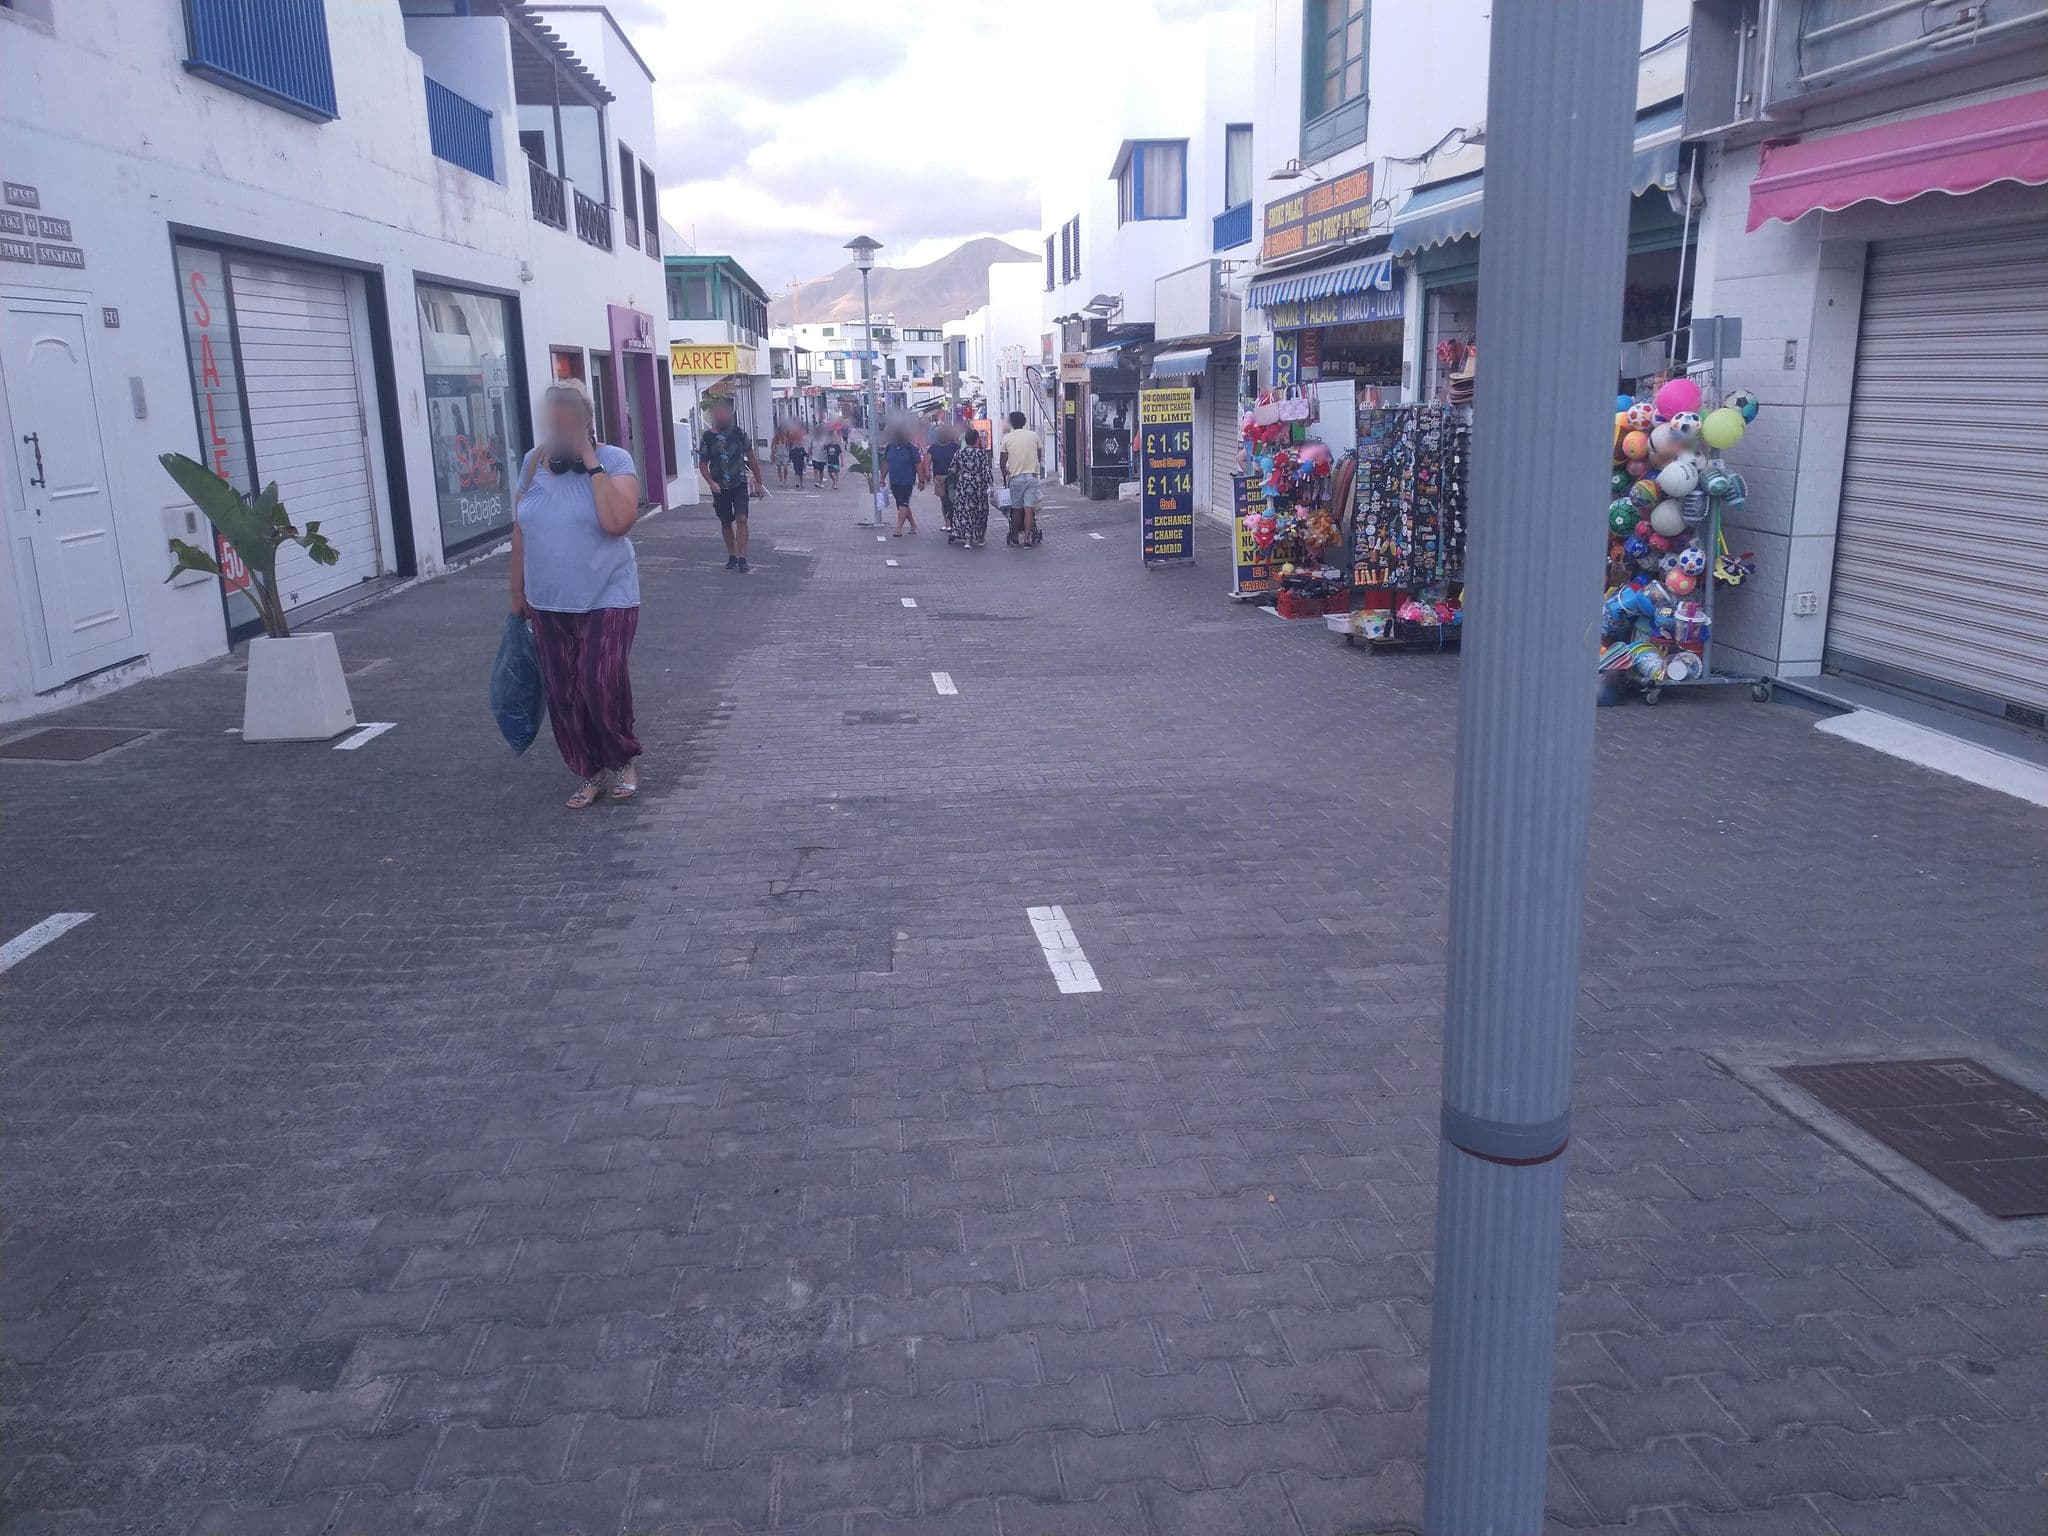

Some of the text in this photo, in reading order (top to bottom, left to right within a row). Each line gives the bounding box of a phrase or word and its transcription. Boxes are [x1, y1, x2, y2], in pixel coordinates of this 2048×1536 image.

[41, 248, 82, 265] SANTANA
[1273, 303, 1300, 328] SMOKE
[1304, 299, 1338, 324] PALACE
[1343, 295, 1369, 321] TABACO
[1377, 290, 1400, 317] LICOR
[1275, 332, 1295, 399] MOK
[1142, 392, 1191, 402] NO COMMISSION
[1142, 402, 1191, 412] NO EXTRA CHARGE
[1143, 413, 1191, 423] NO LIMIT
[1147, 433, 1156, 454] £
[1147, 476, 1156, 496] £
[460, 493, 502, 526] Rebajas
[1159, 498, 1177, 510] Cash
[1154, 515, 1192, 526] EXCHANGE
[1154, 529, 1183, 540] CHANGE
[1154, 543, 1182, 554] CAMBIO
